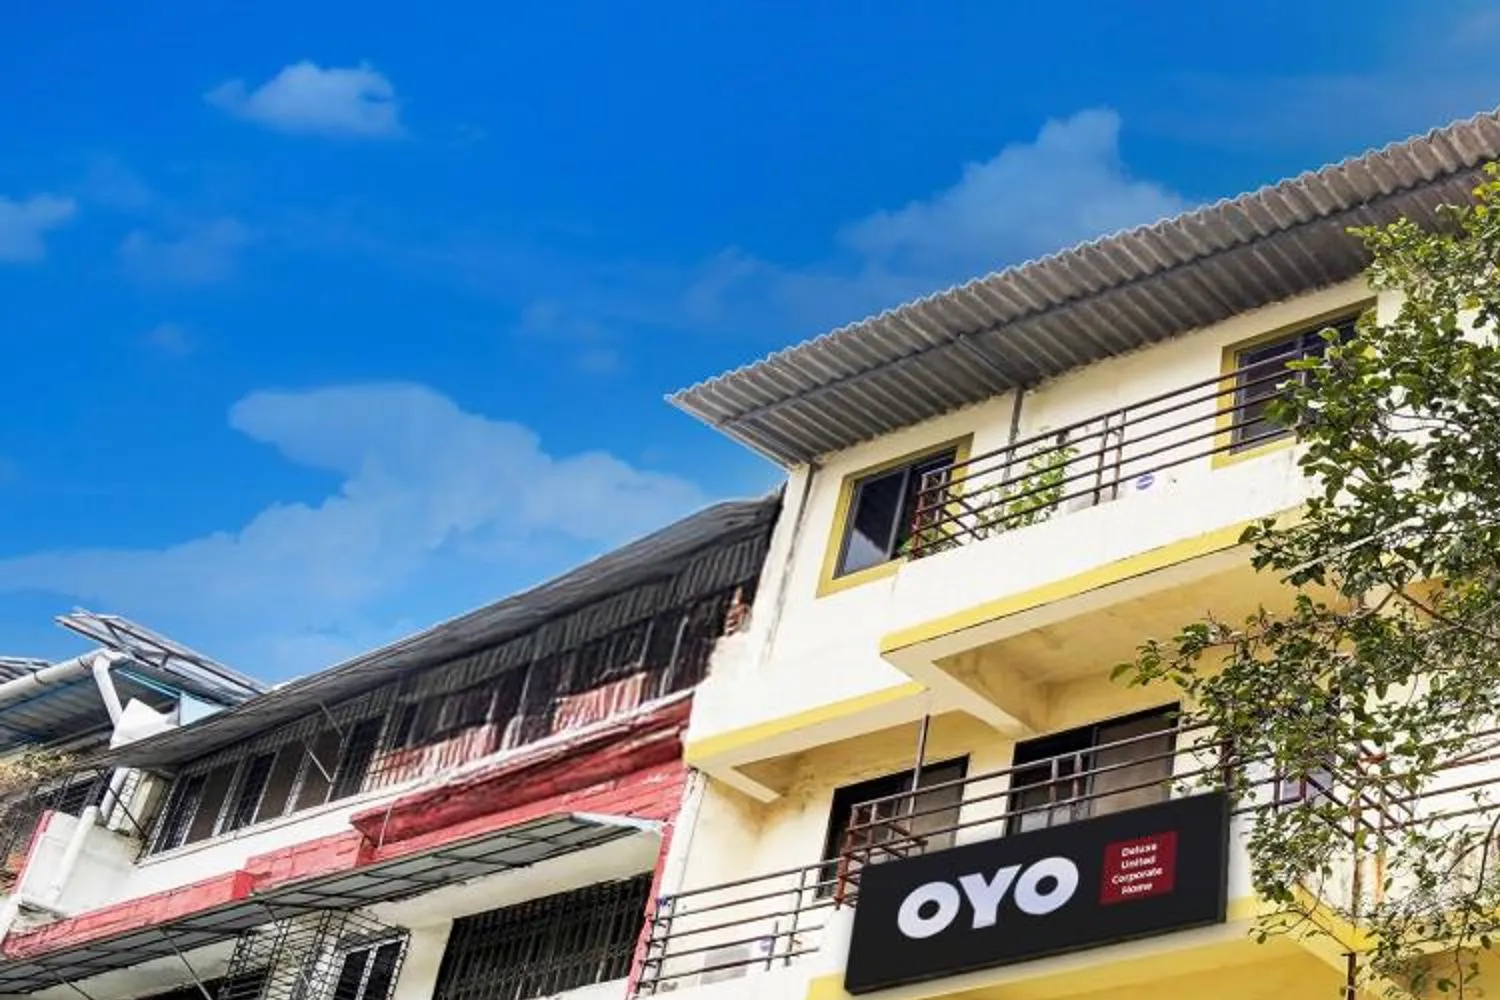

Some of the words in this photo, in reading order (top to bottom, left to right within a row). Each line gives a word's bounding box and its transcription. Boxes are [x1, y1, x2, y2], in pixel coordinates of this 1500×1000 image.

[1121, 855, 1156, 869] United
[1111, 867, 1163, 884] Corporate
[897, 856, 1079, 939] OYO
